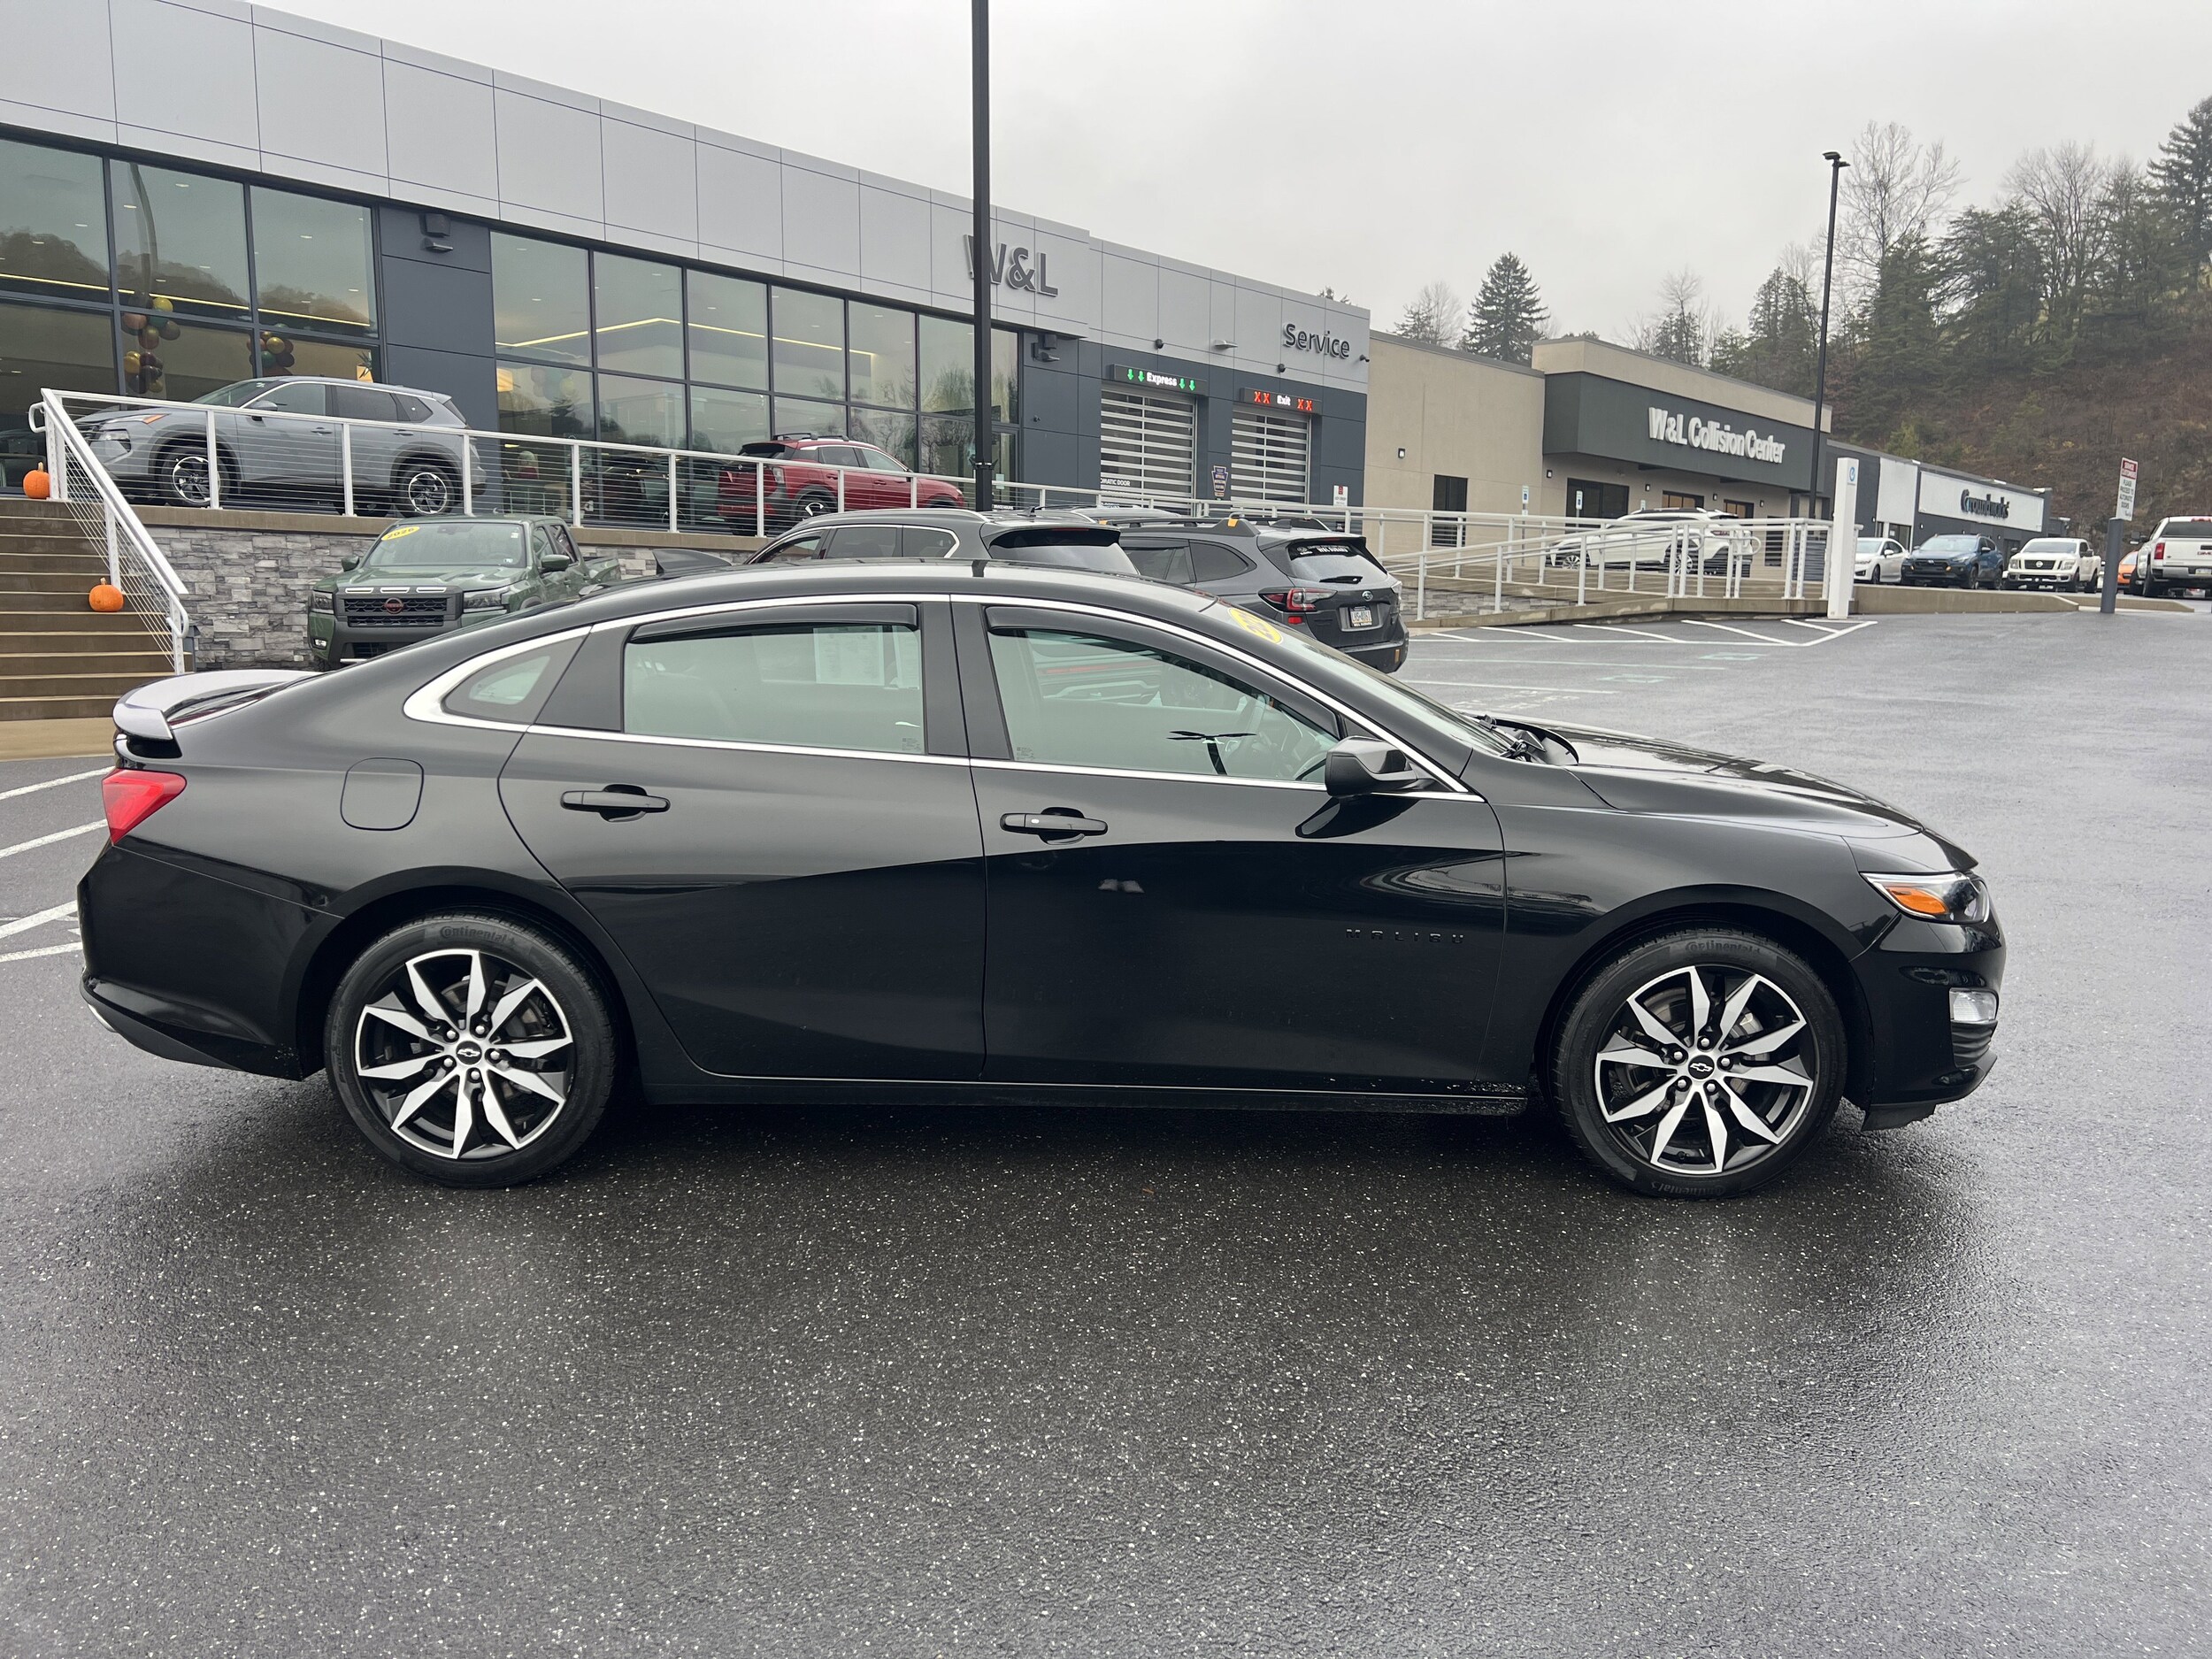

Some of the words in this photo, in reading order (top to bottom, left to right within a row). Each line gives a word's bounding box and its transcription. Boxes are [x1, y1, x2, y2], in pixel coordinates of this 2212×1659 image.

[963, 234, 1058, 297] W&L
[1283, 322, 1350, 360] Service
[1146, 372, 1178, 387] Express
[1277, 395, 1291, 406] Exit
[1648, 407, 1687, 445] W&L
[1688, 417, 1745, 457] Collision
[1745, 429, 1786, 464] Center
[1961, 488, 2010, 519] Groundworks
[388, 526, 416, 539] 2026
[440, 926, 509, 943] Continental
[1346, 928, 1464, 944] MALIBU
[1685, 941, 1753, 953] Continental
